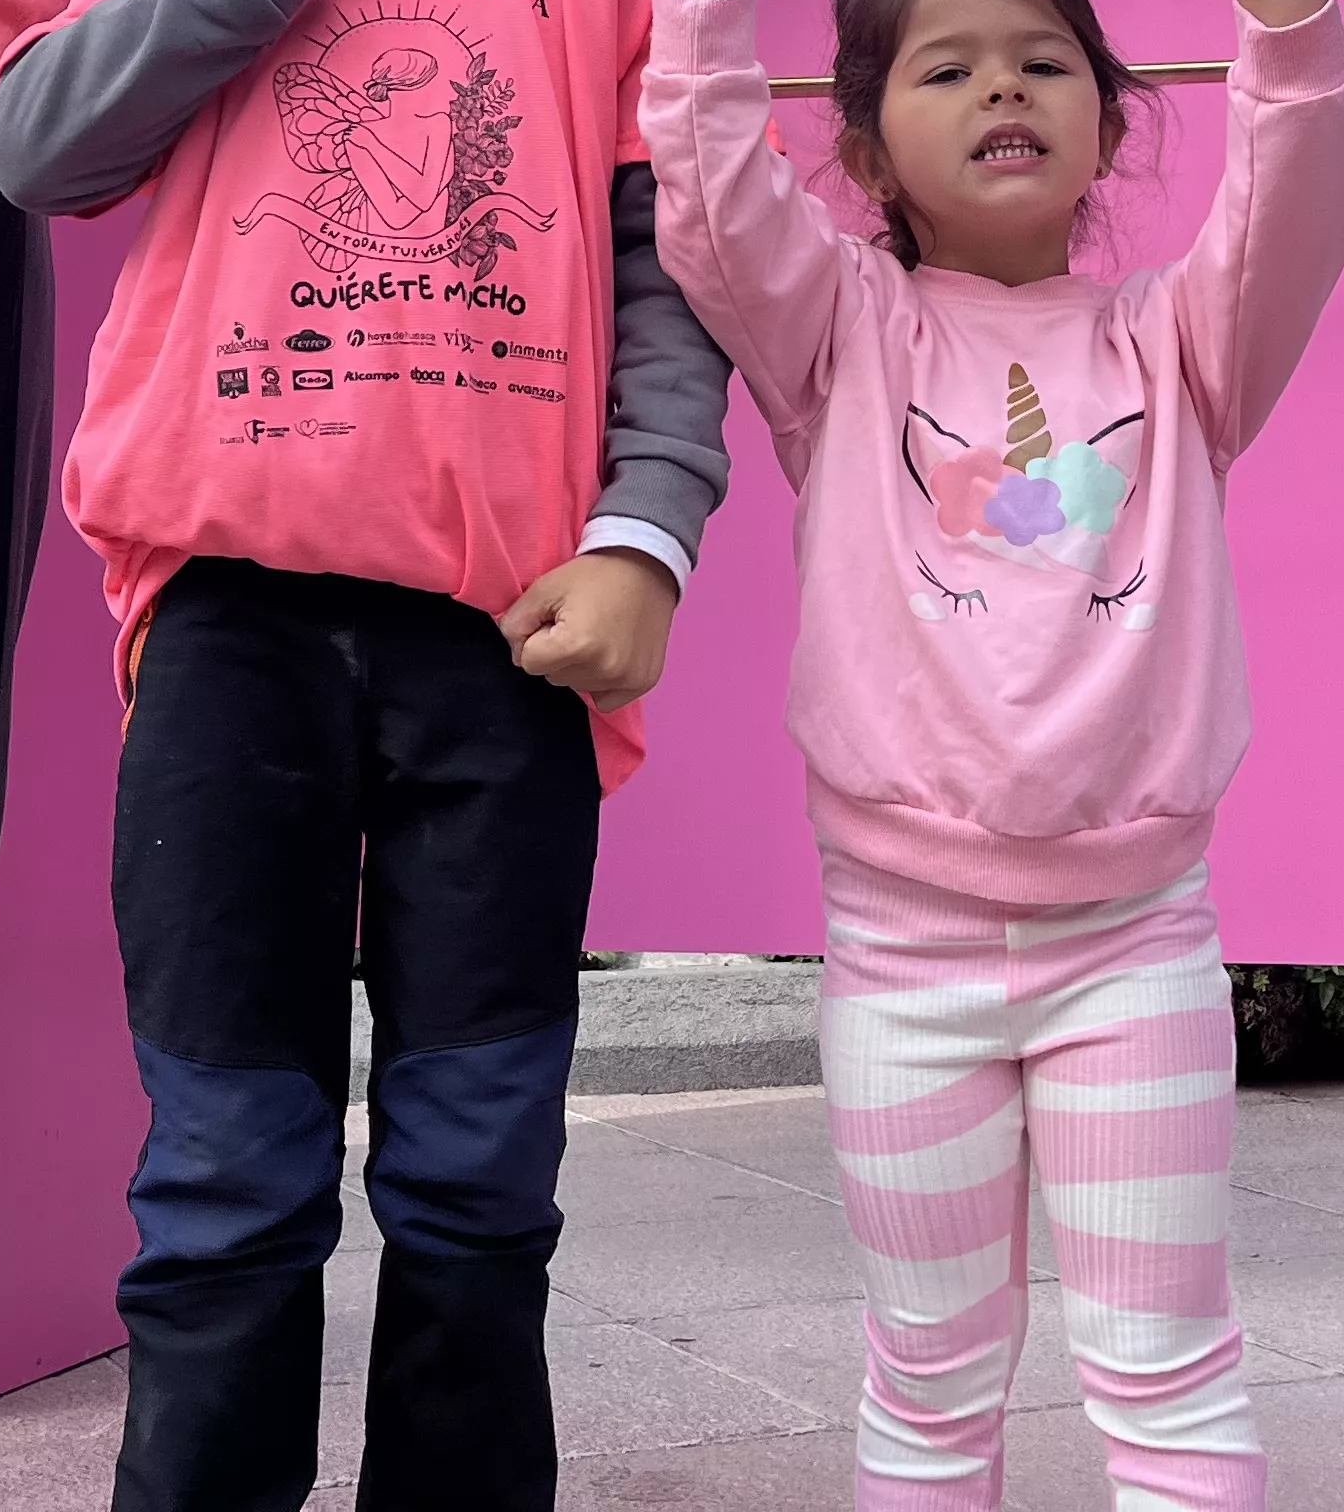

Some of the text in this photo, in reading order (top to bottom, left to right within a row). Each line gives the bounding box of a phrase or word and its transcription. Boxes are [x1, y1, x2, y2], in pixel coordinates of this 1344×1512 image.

[319, 222, 341, 239] EN
[343, 235, 386, 254] TODAS
[391, 245, 418, 258] TUS
